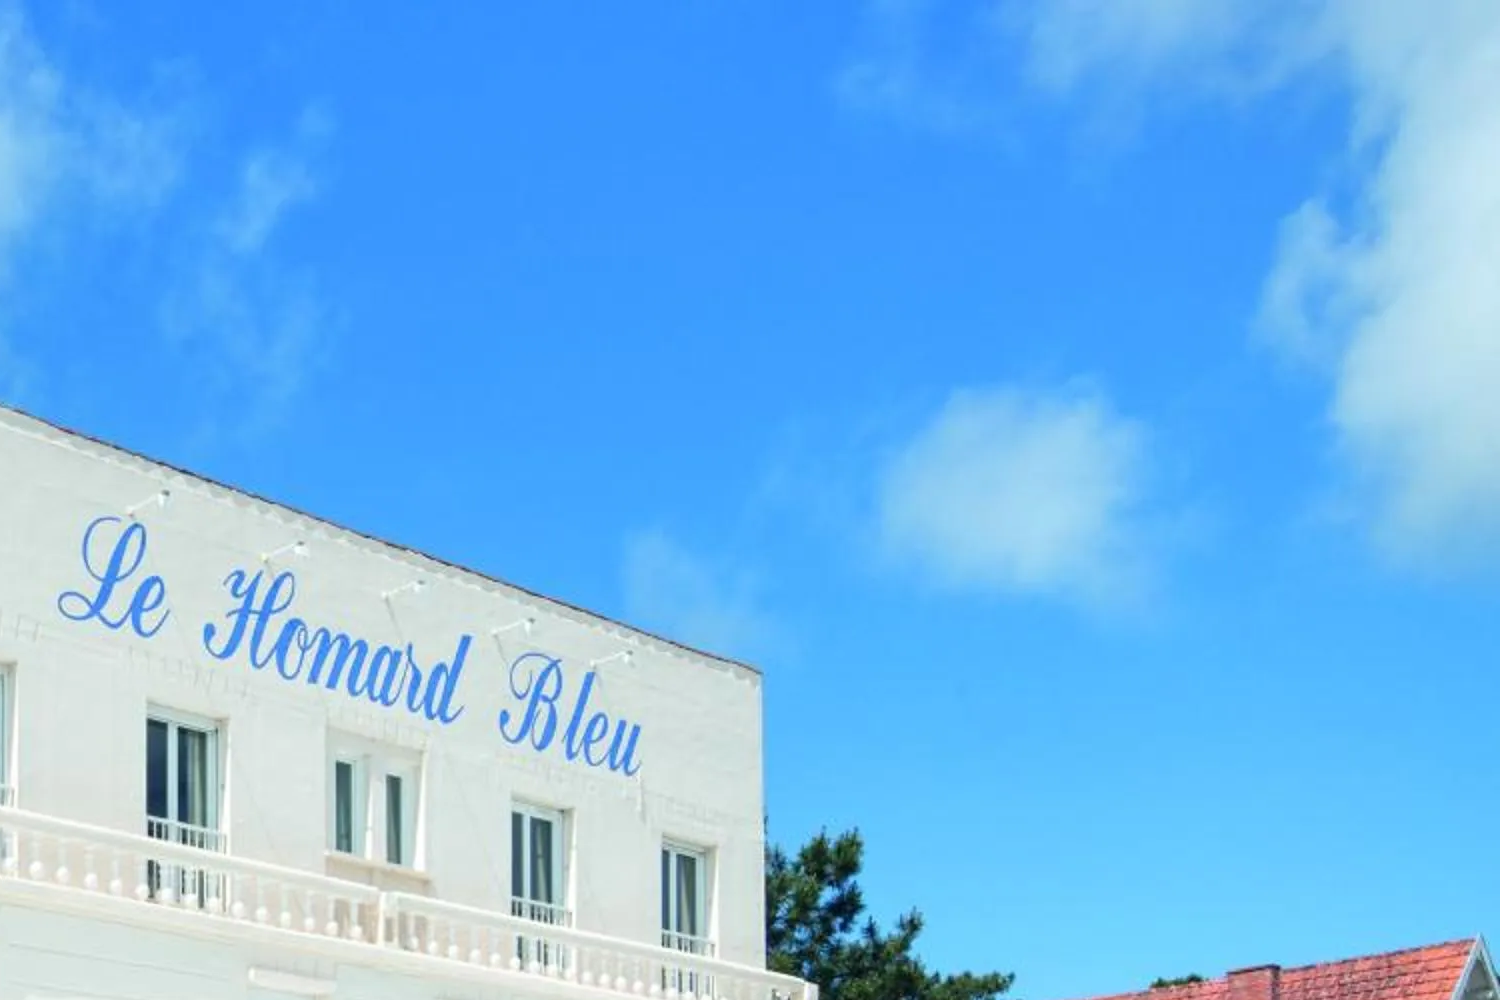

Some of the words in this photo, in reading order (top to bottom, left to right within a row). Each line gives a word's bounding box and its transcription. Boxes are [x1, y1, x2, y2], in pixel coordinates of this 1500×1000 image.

[57, 516, 171, 638] Le
[202, 568, 473, 725] Homard
[500, 652, 642, 778] Bleu
